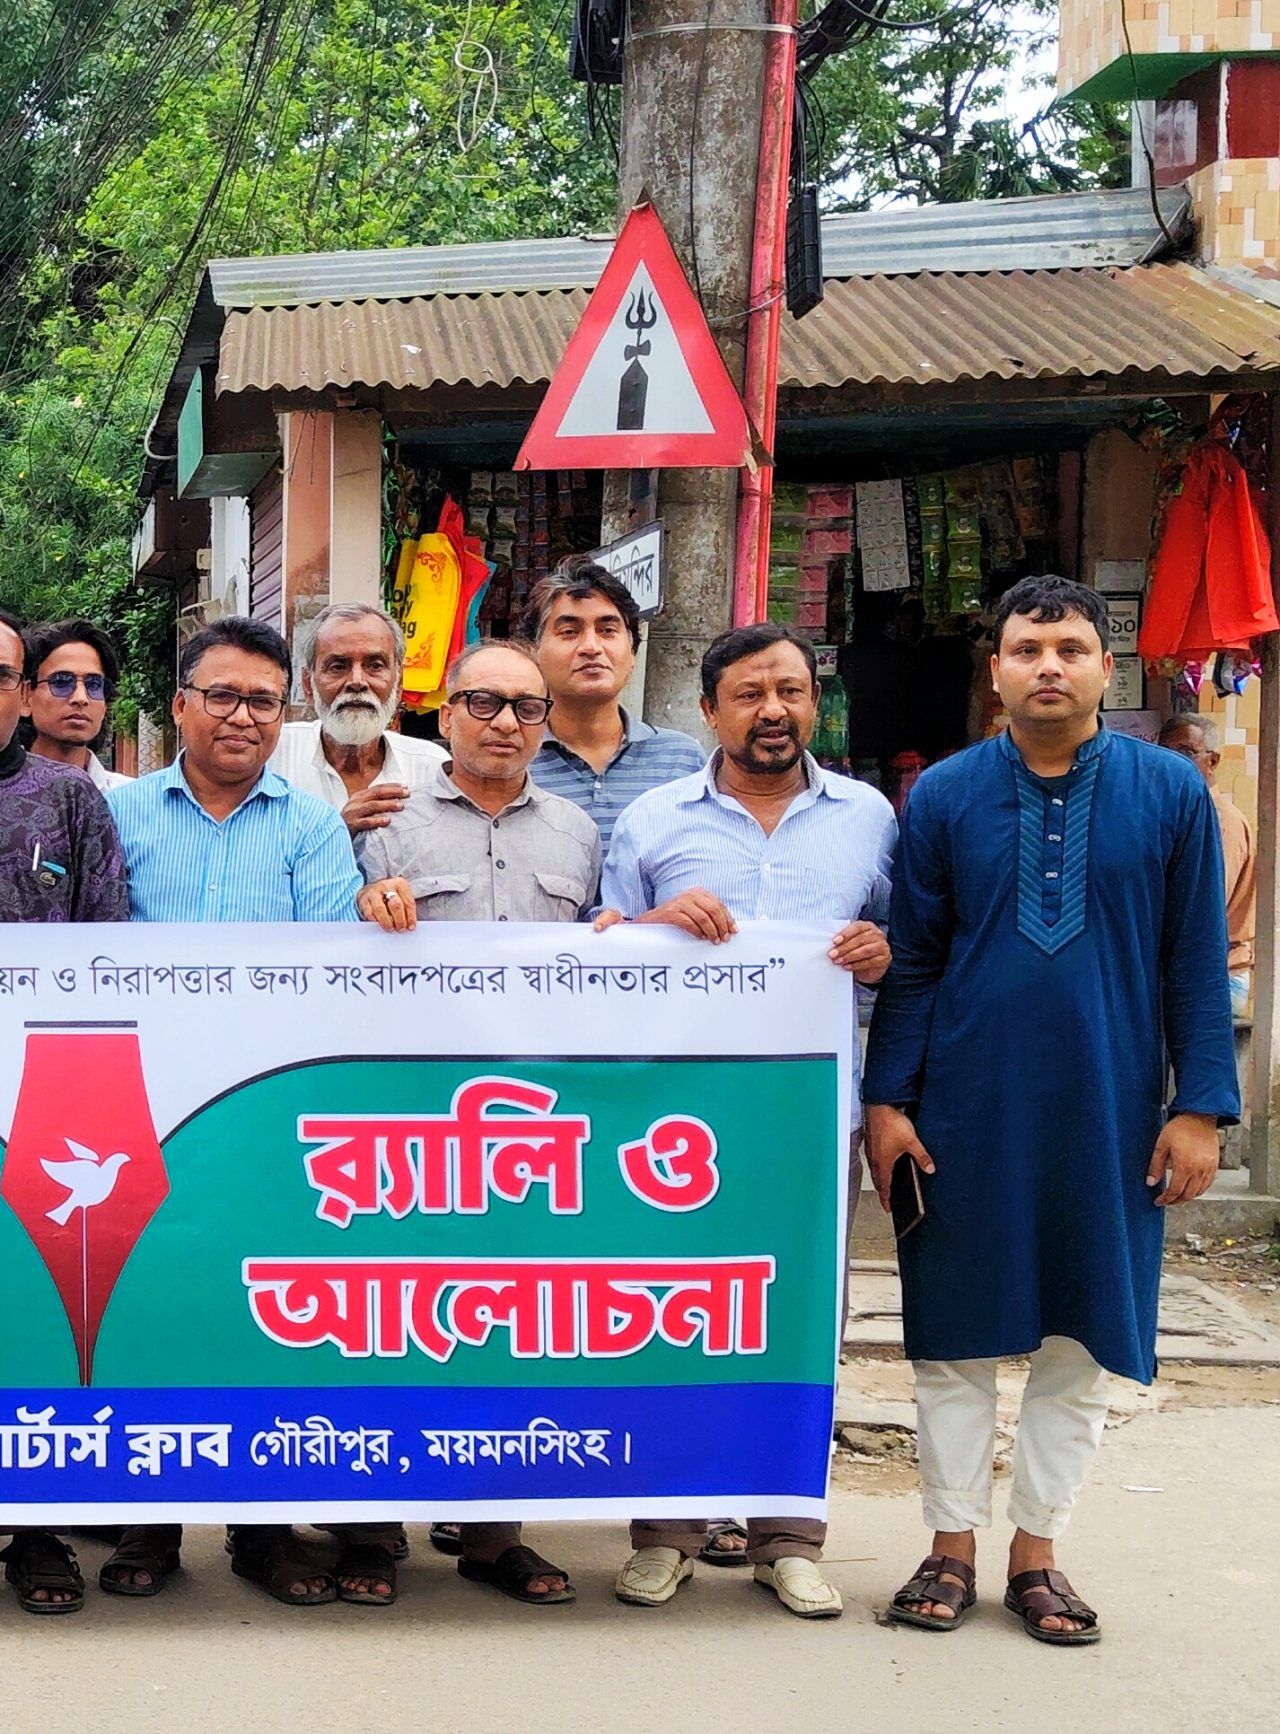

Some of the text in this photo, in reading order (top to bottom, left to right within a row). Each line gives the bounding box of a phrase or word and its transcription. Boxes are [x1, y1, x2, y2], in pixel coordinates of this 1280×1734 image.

[53, 969, 75, 992] ও
[89, 956, 234, 994] নিরাপত্তার
[247, 967, 310, 994] জন্য
[324, 964, 507, 995] সংবাদপত্রের
[522, 954, 670, 993] স্বাধীনতার
[618, 1115, 719, 1212] ও
[242, 1255, 775, 1362] আলোচনা
[126, 1425, 231, 1474] ক্লাব
